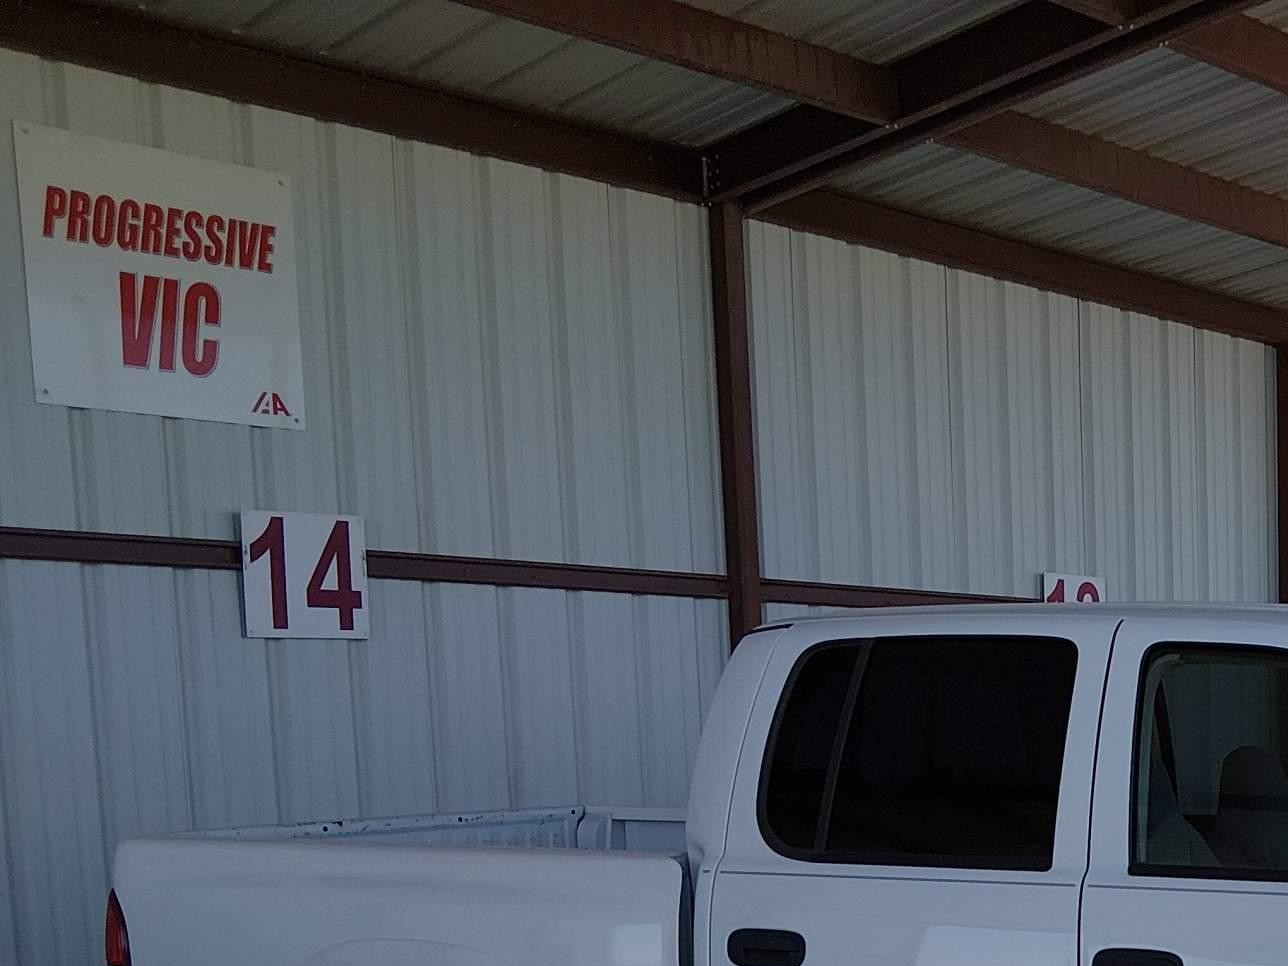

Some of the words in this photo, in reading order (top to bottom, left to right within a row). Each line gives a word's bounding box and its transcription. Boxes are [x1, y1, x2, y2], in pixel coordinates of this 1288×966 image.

[42, 186, 275, 273] PROGRESSIVE
[119, 272, 222, 378] VIC
[252, 392, 290, 416] IAA
[250, 517, 363, 630] 14
